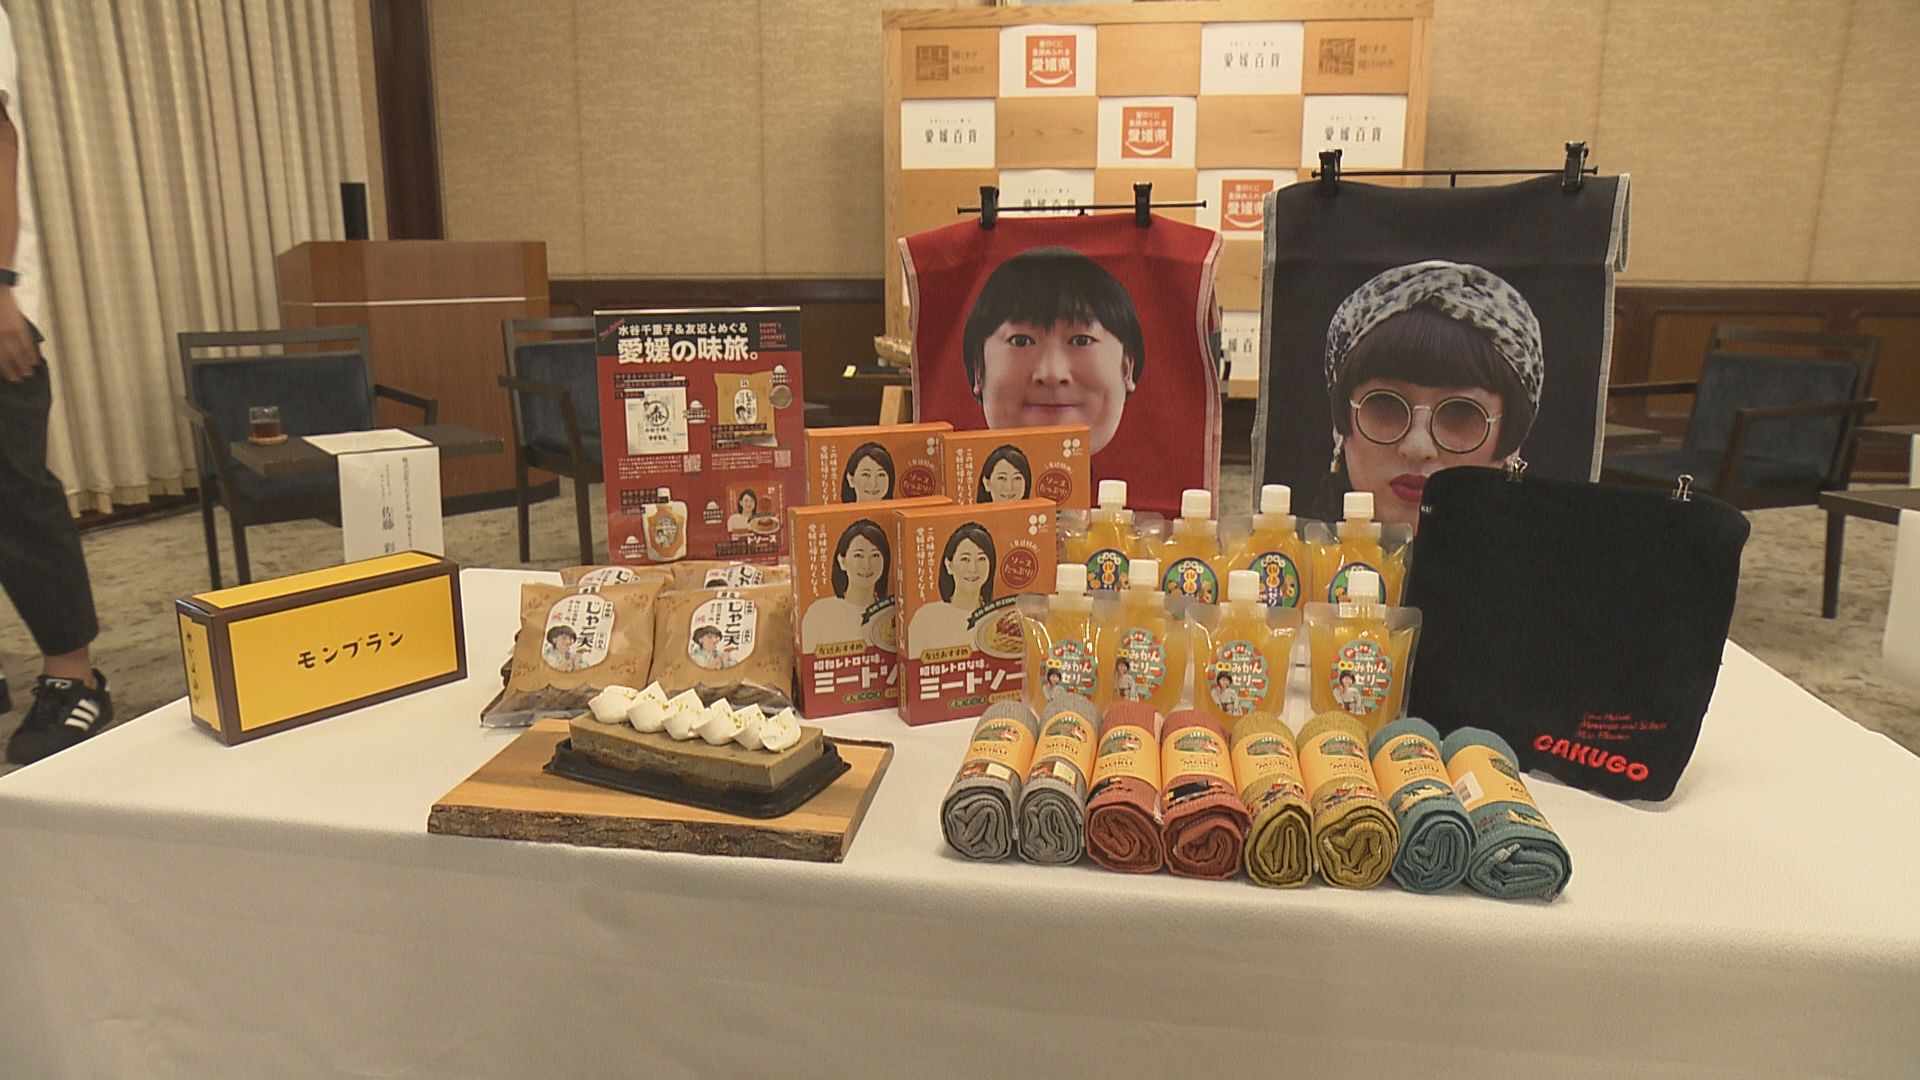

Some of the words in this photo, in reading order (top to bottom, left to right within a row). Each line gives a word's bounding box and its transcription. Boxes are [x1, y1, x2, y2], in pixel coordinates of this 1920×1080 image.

[618, 322, 748, 336] 水谷千重子&友近とめぐる
[618, 335, 758, 364] 愛媛の味旅。
[1011, 556, 1032, 567] ソース
[577, 601, 601, 648] じゃこ天
[724, 602, 743, 647] じゃこ天
[297, 630, 404, 669] モンブラン
[1129, 650, 1160, 662] みかん
[814, 664, 898, 694] ミートソ
[1062, 661, 1092, 673] みかん
[1231, 661, 1263, 673] みかん
[1354, 661, 1387, 673] みかん
[920, 669, 1024, 700] ミートソー
[1533, 735, 1649, 781] CAKUGO
